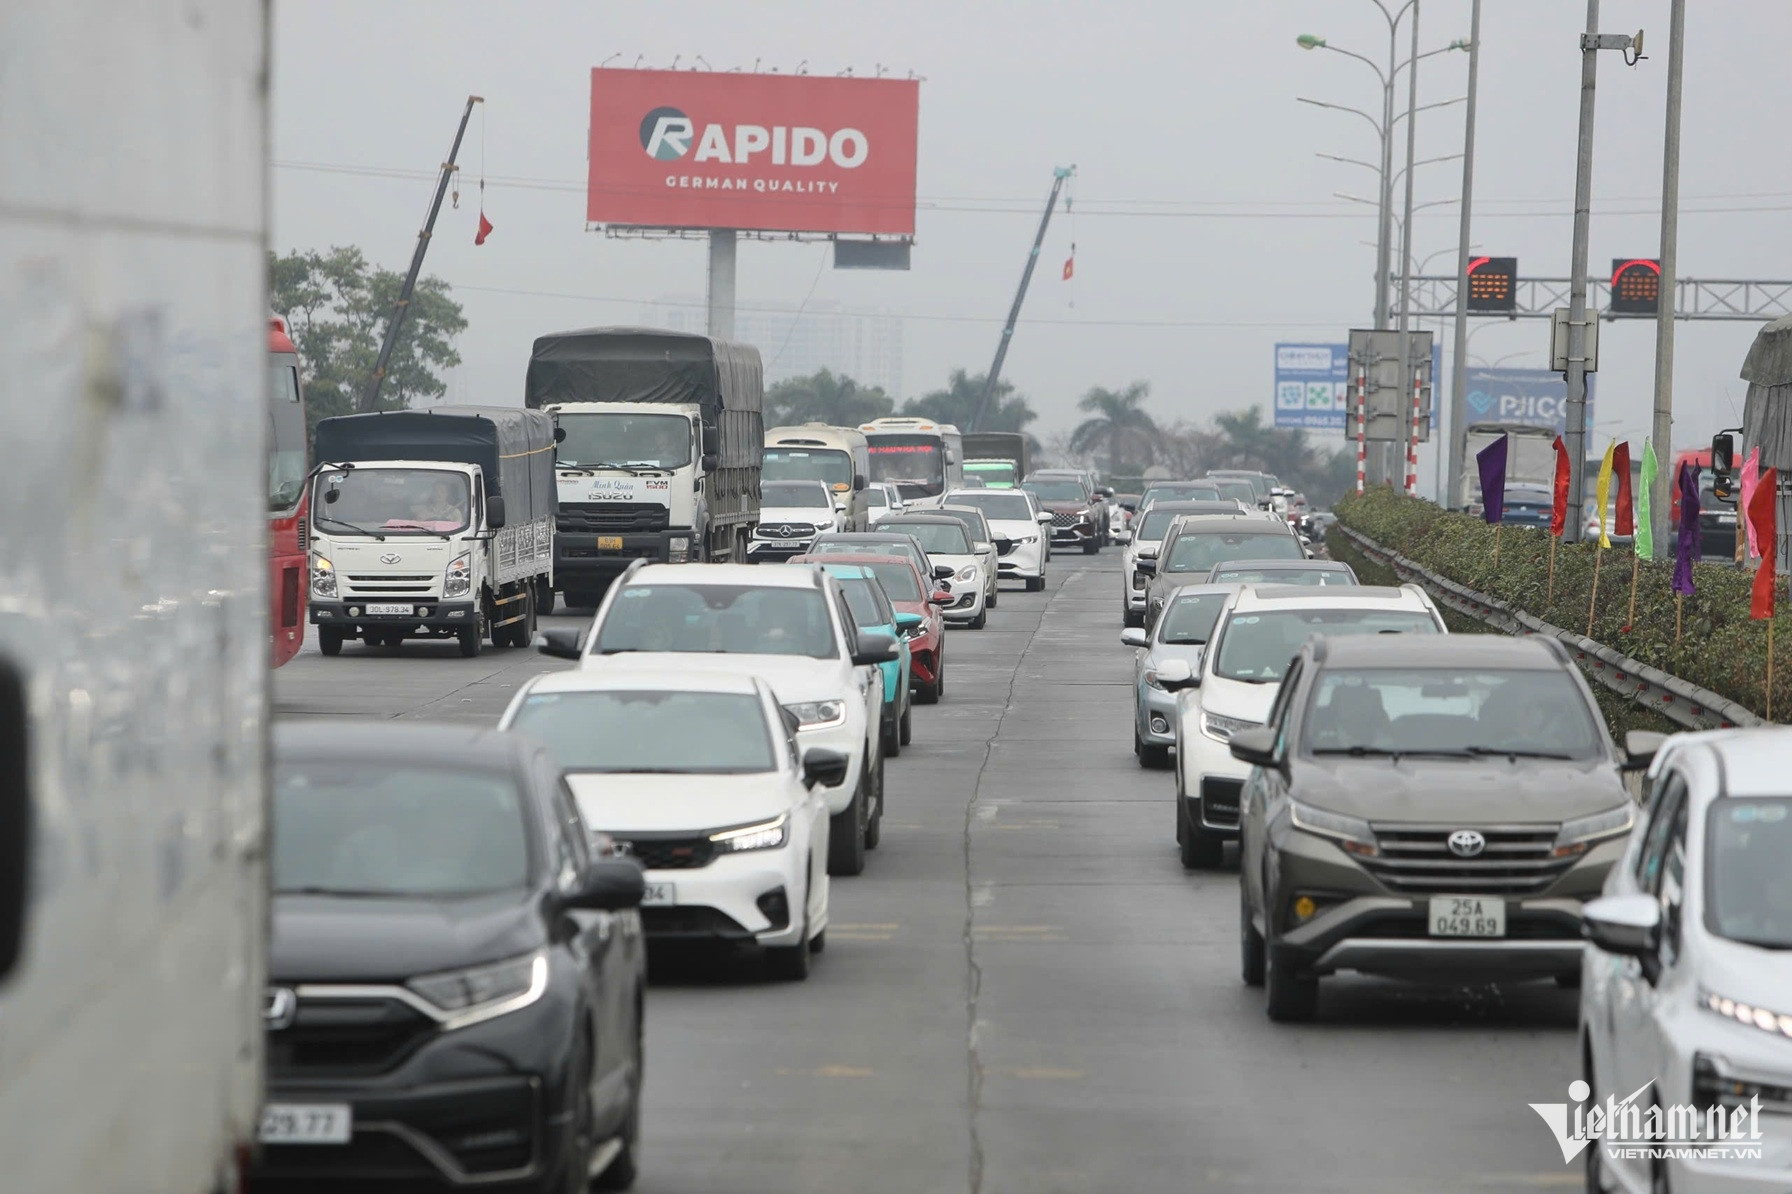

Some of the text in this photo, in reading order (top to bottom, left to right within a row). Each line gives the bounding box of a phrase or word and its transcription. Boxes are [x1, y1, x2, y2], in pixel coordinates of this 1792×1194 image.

[645, 115, 869, 169] RAPIDO
[666, 175, 839, 194] GERMAN QUALITY
[588, 491, 633, 500] ISUZU
[1451, 900, 1483, 915] 25A
[1437, 917, 1497, 935] 049.69
